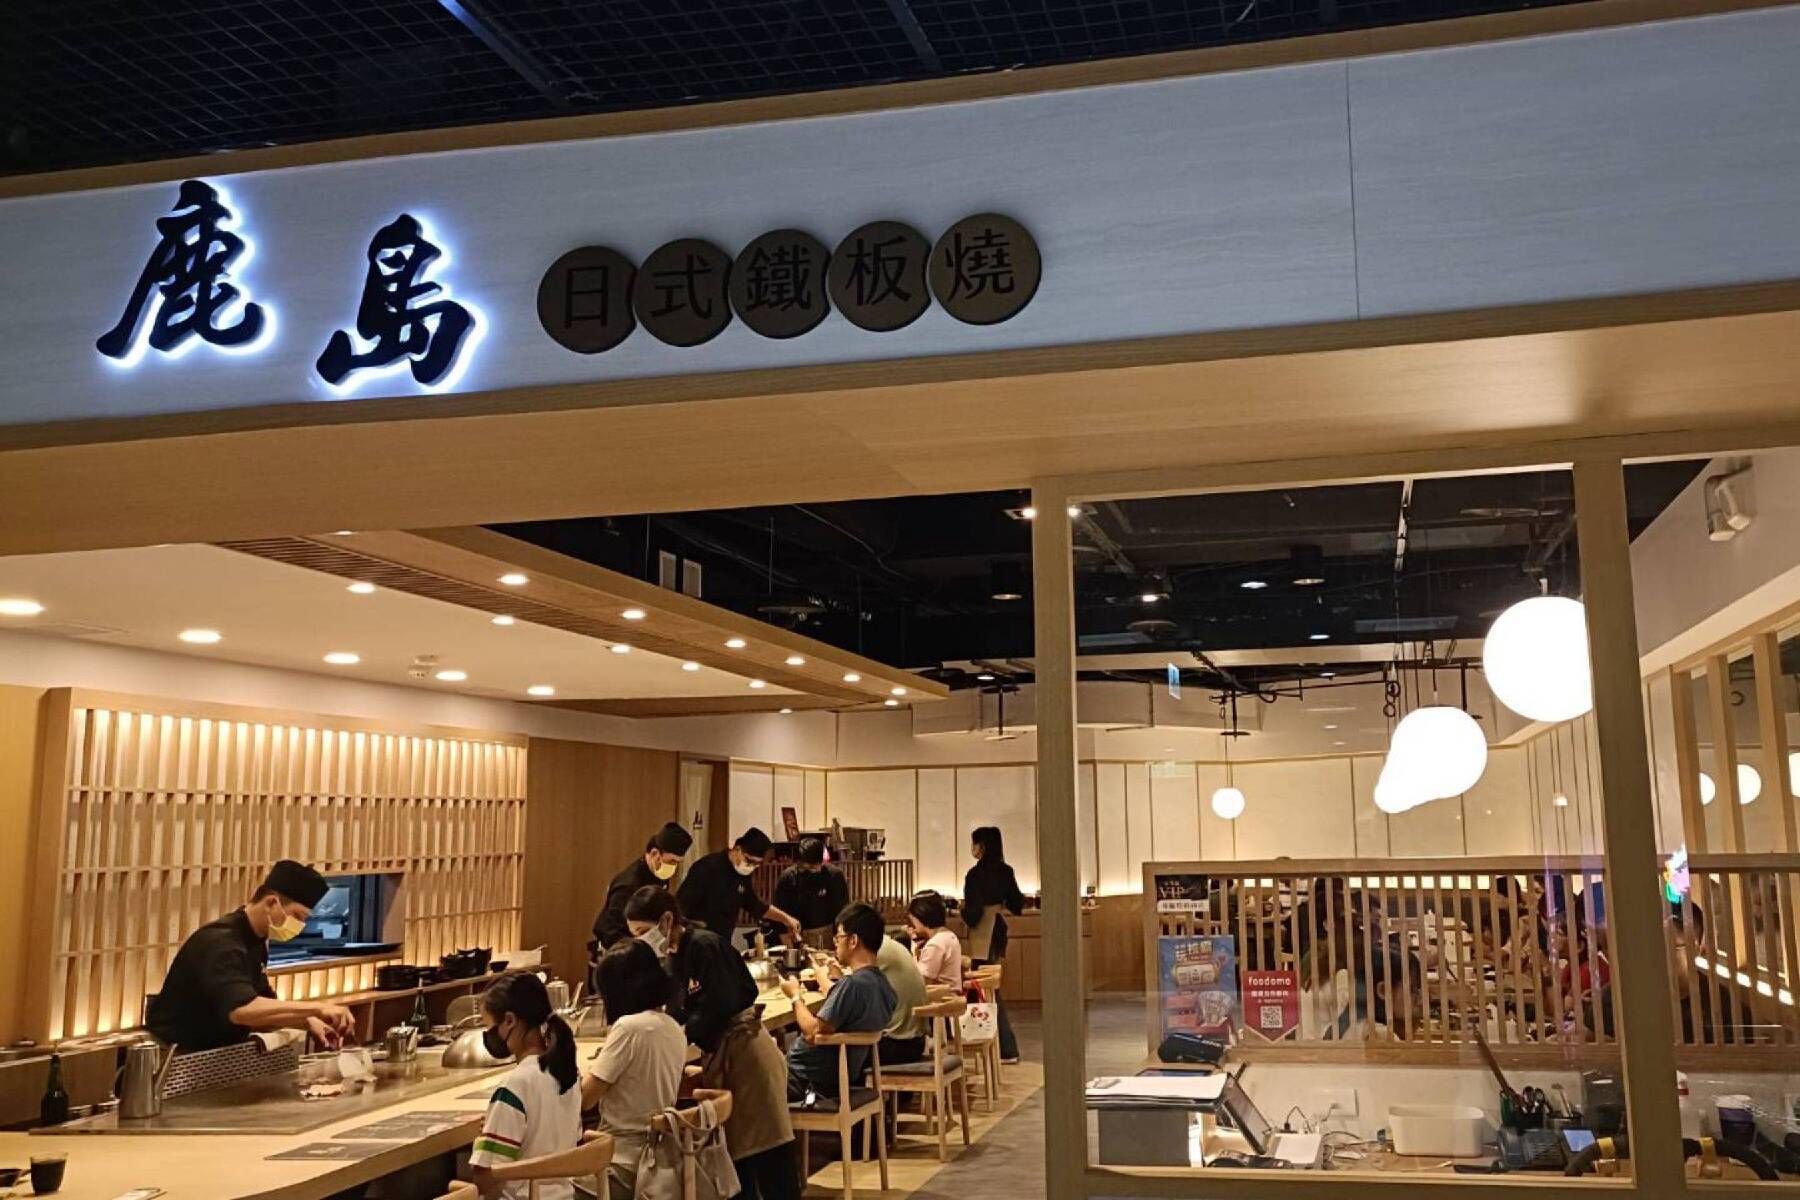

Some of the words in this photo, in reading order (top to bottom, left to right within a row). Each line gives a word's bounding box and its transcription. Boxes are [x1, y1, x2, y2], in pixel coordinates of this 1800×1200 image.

[97, 180, 476, 385] 鹿島
[563, 228, 1015, 329] 日式鐵板燒
